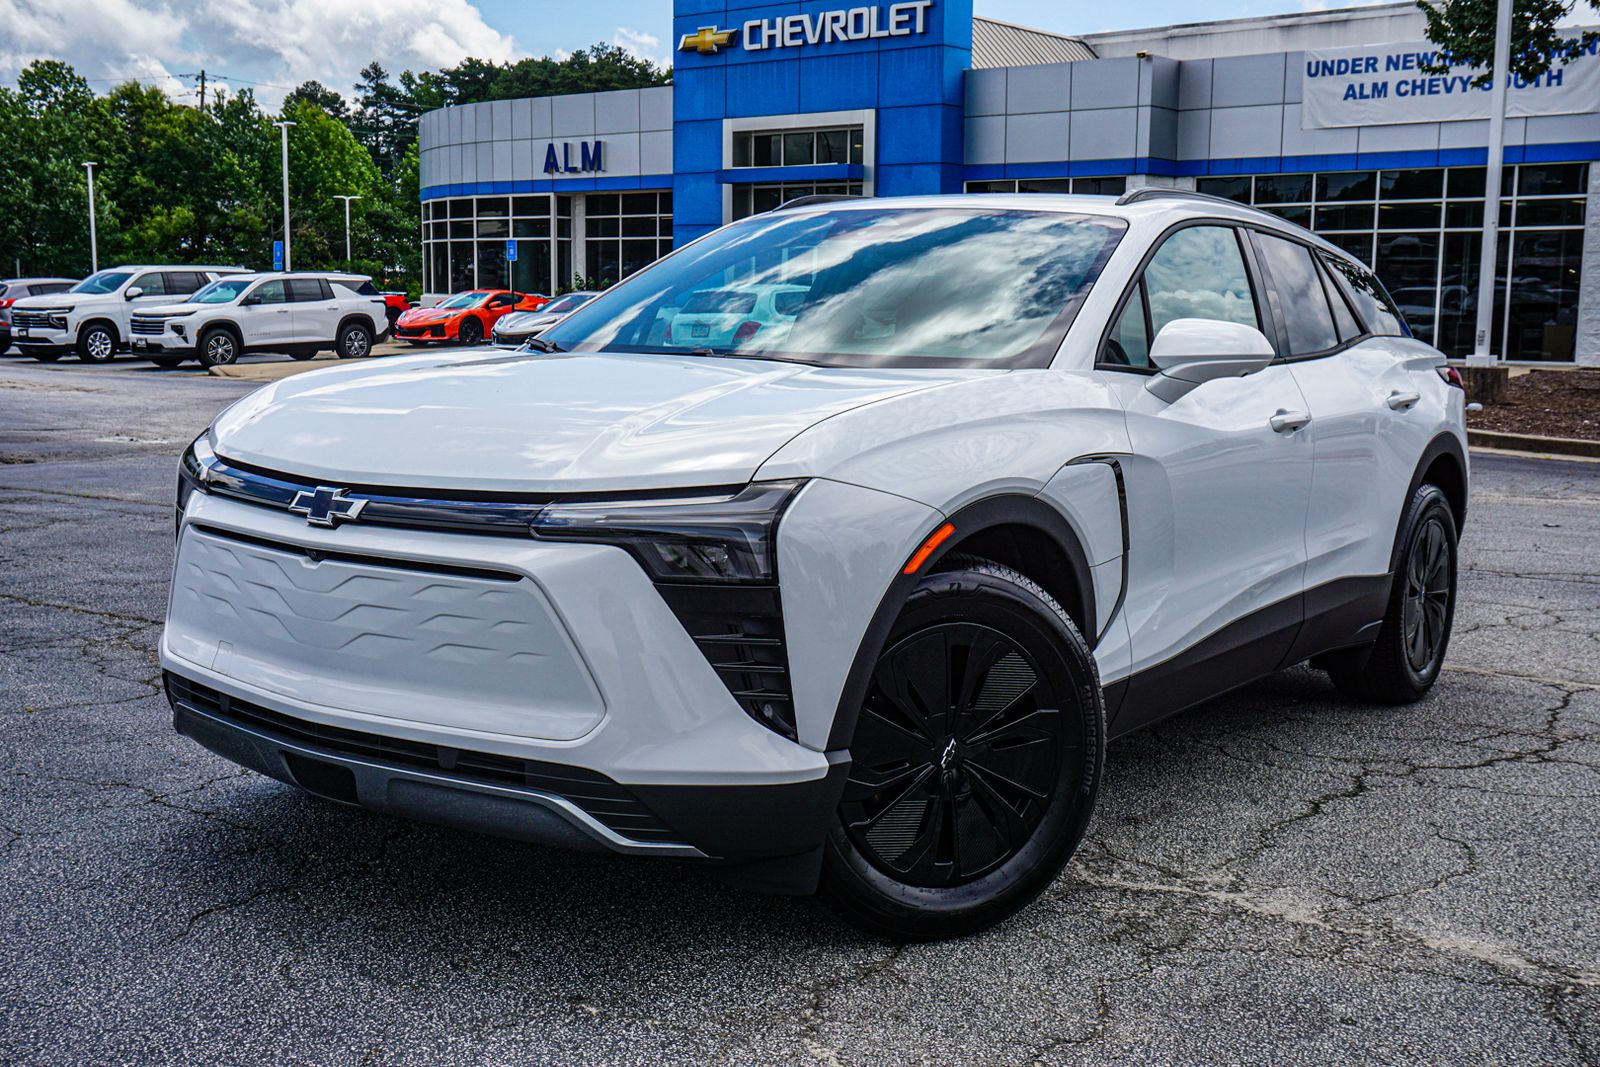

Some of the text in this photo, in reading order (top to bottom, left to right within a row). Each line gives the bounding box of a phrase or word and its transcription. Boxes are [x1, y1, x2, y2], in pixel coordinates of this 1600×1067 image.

[743, 0, 932, 51] CHEVROLET
[1306, 56, 1378, 78] UNDER
[1385, 51, 1438, 72] NEW
[1343, 81, 1388, 101] ALM
[1395, 75, 1473, 97] CHEVY
[543, 141, 603, 173] ALM
